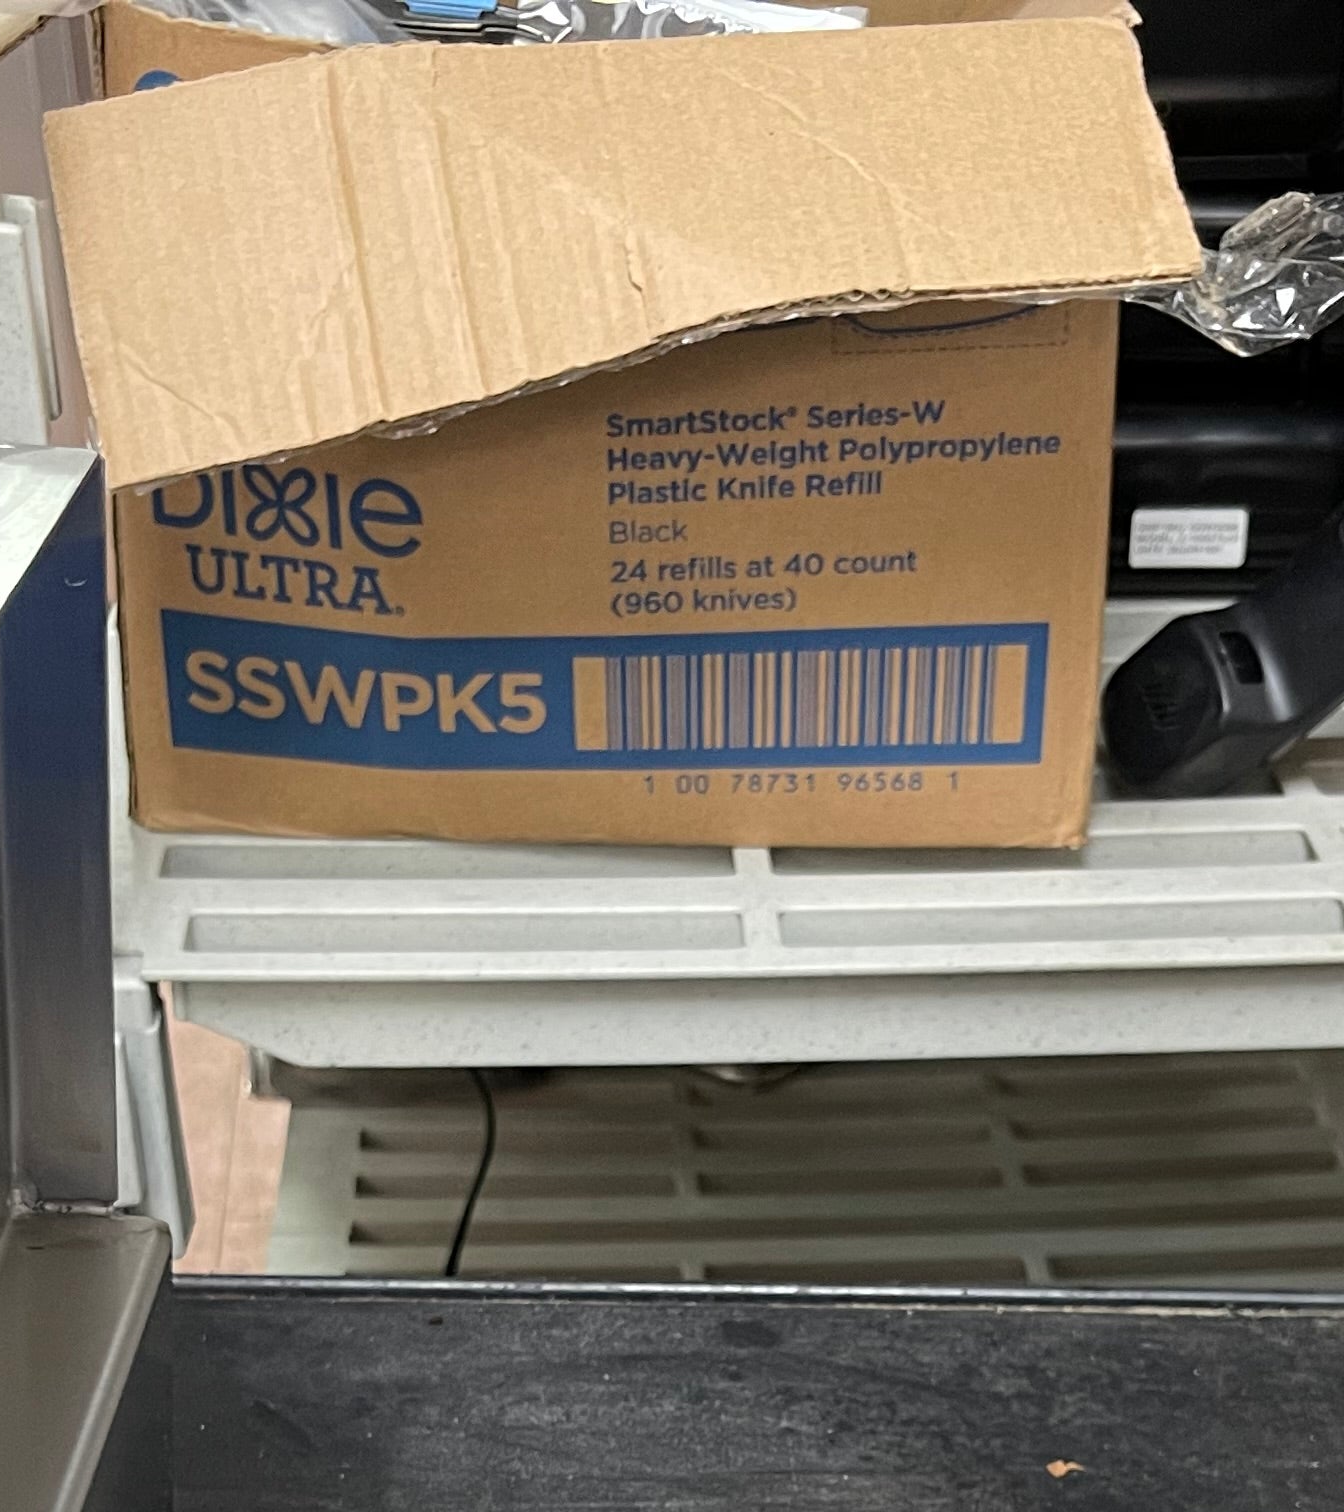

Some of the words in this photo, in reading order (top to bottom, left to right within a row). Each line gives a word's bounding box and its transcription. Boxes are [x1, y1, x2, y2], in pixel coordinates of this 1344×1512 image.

[808, 399, 945, 430] Series-W
[607, 440, 830, 474] Heavy-Weight
[839, 431, 1062, 464] Polypropylene
[608, 478, 706, 505] Plastic
[718, 475, 795, 501] Knife
[806, 470, 883, 497] Refill
[609, 519, 689, 545] Black
[611, 559, 648, 584] 24
[659, 555, 737, 582] refills
[747, 555, 775, 578] at
[784, 551, 824, 577] 40
[834, 550, 918, 575] count
[611, 590, 683, 618] (960
[692, 587, 798, 613] knives)
[185, 649, 548, 735] SSWPK5
[643, 774, 655, 795] 1
[674, 773, 711, 795] 00
[731, 772, 817, 795] 78731
[837, 770, 924, 793] 96568
[946, 770, 959, 791] 1
